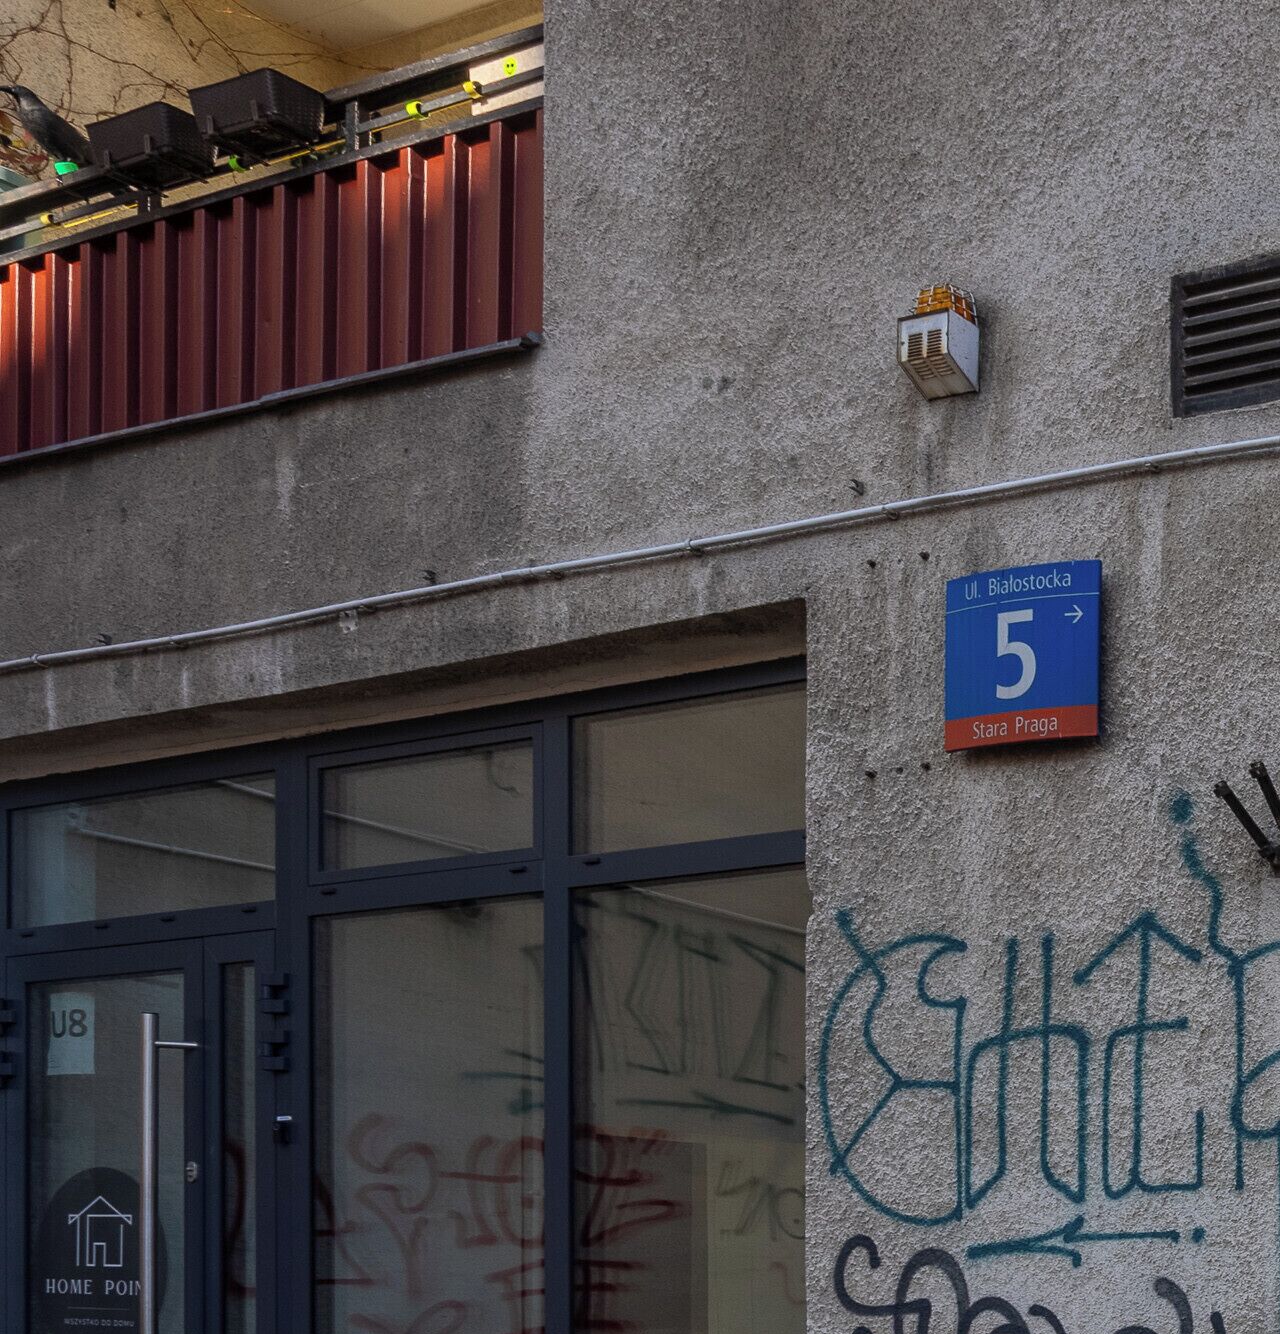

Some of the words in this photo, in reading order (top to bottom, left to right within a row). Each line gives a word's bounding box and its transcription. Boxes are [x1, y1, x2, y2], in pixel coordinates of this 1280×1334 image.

[965, 580, 981, 600] Ul.
[988, 569, 1072, 596] Białostocka
[996, 608, 1037, 700] 5
[972, 720, 1008, 740] Stara
[1015, 716, 1058, 737] Praga
[51, 1008, 88, 1039] U8
[45, 1278, 93, 1295] HOME
[105, 1279, 142, 1296] POIN
